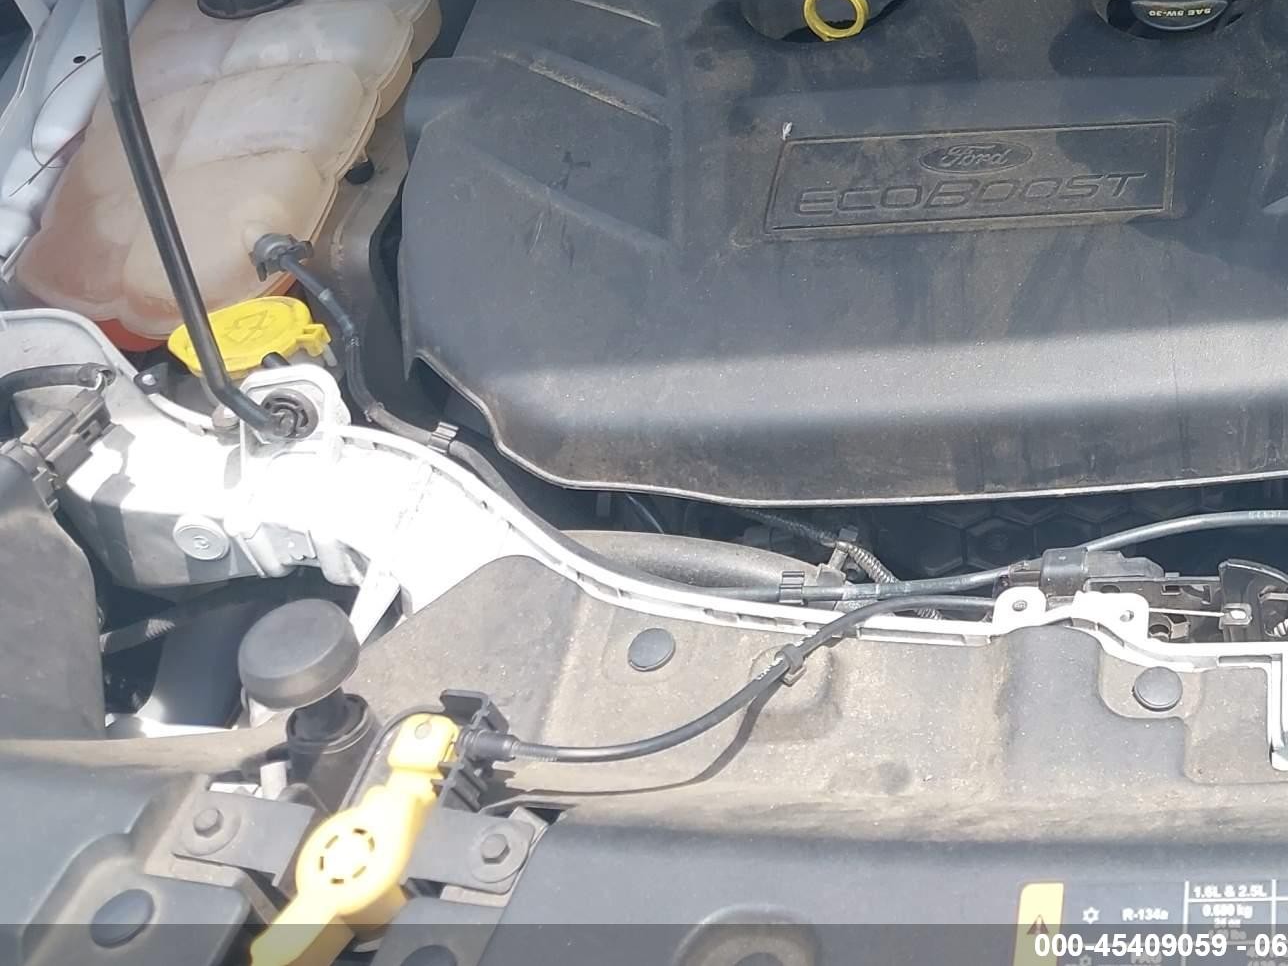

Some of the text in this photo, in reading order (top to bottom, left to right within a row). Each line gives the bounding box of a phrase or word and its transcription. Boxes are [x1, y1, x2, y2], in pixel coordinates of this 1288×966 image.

[1187, 7, 1212, 16] SAE
[798, 172, 1147, 216] ECOBOOST
[1224, 885, 1236, 898] &
[1238, 884, 1268, 898] 2.5L
[1122, 907, 1169, 921] R-134a
[1236, 903, 1254, 919] kg
